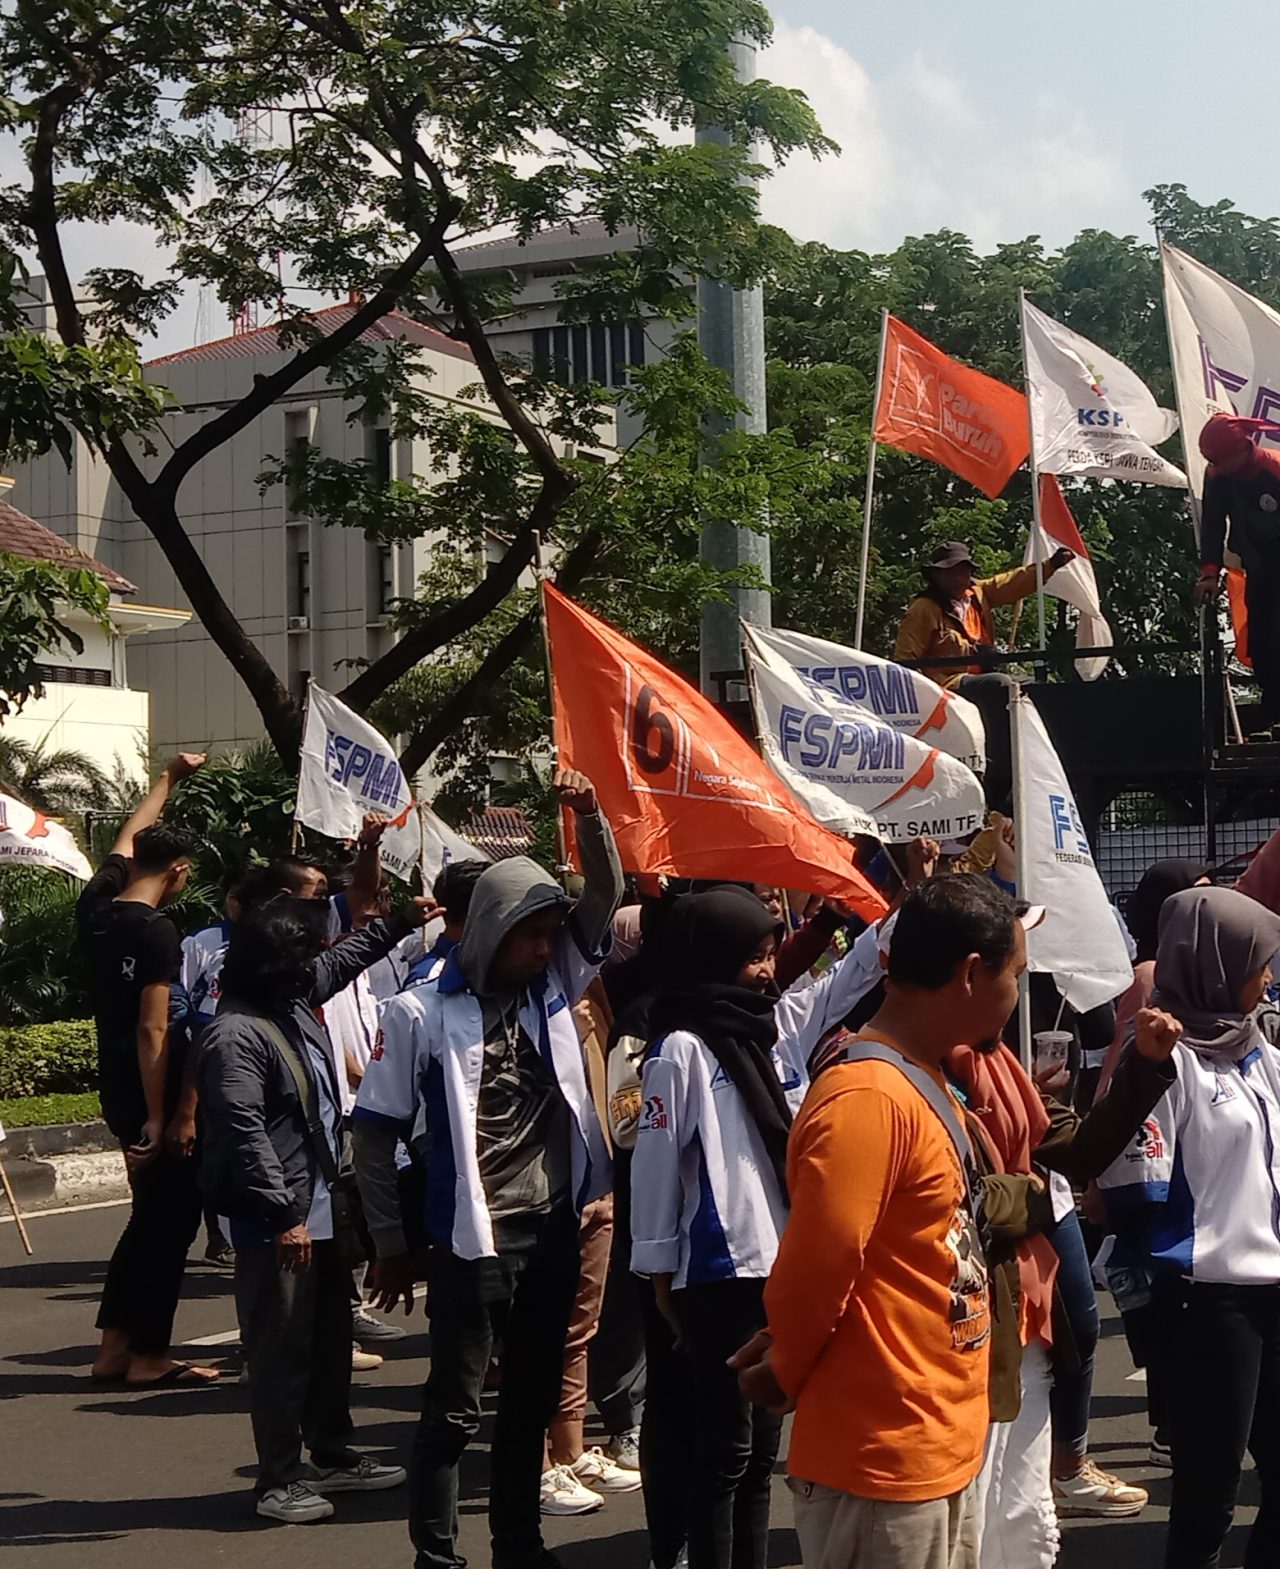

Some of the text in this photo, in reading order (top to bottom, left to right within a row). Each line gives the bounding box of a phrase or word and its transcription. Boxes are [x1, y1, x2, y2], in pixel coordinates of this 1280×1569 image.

[1077, 408, 1131, 429] KSP
[634, 684, 674, 774] 6
[779, 704, 905, 771] FSPMI
[877, 822, 902, 838] PT.
[906, 820, 951, 837] SAMI
[14, 846, 50, 859] JEPARA
[651, 1113, 668, 1130] all
[1145, 1142, 1164, 1159] all
